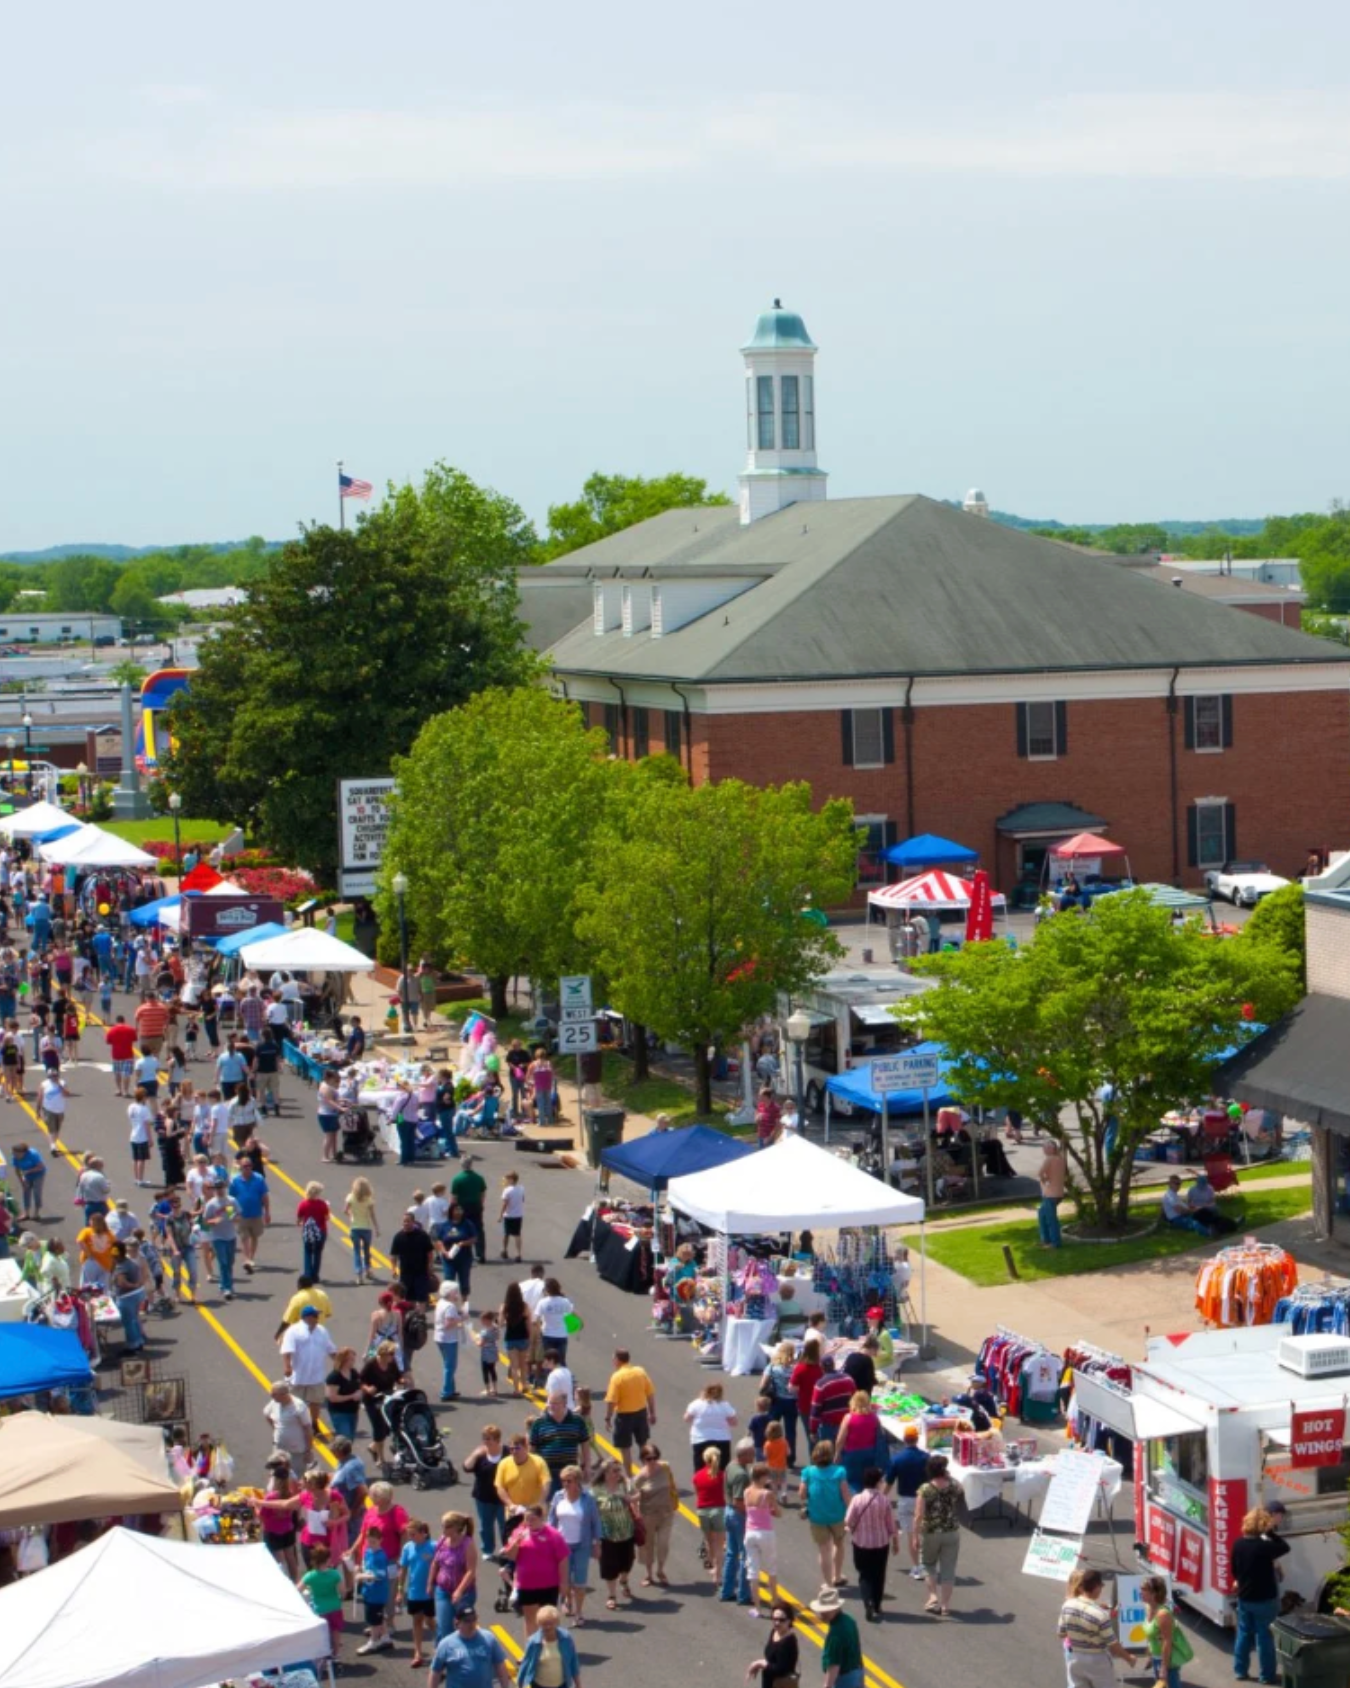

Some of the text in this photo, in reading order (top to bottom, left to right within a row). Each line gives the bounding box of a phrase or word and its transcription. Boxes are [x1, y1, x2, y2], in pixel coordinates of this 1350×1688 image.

[348, 796, 361, 805] SAT
[371, 805, 380, 813] TO
[348, 815, 376, 824] CRAFTS
[566, 1010, 586, 1018] WEST
[565, 1026, 590, 1043] 25
[874, 1057, 935, 1072] PUBLIC PARKING
[1303, 1418, 1334, 1433] HOT
[1294, 1438, 1343, 1456] WINGS
[1215, 1484, 1229, 1589] HAMBURGER
